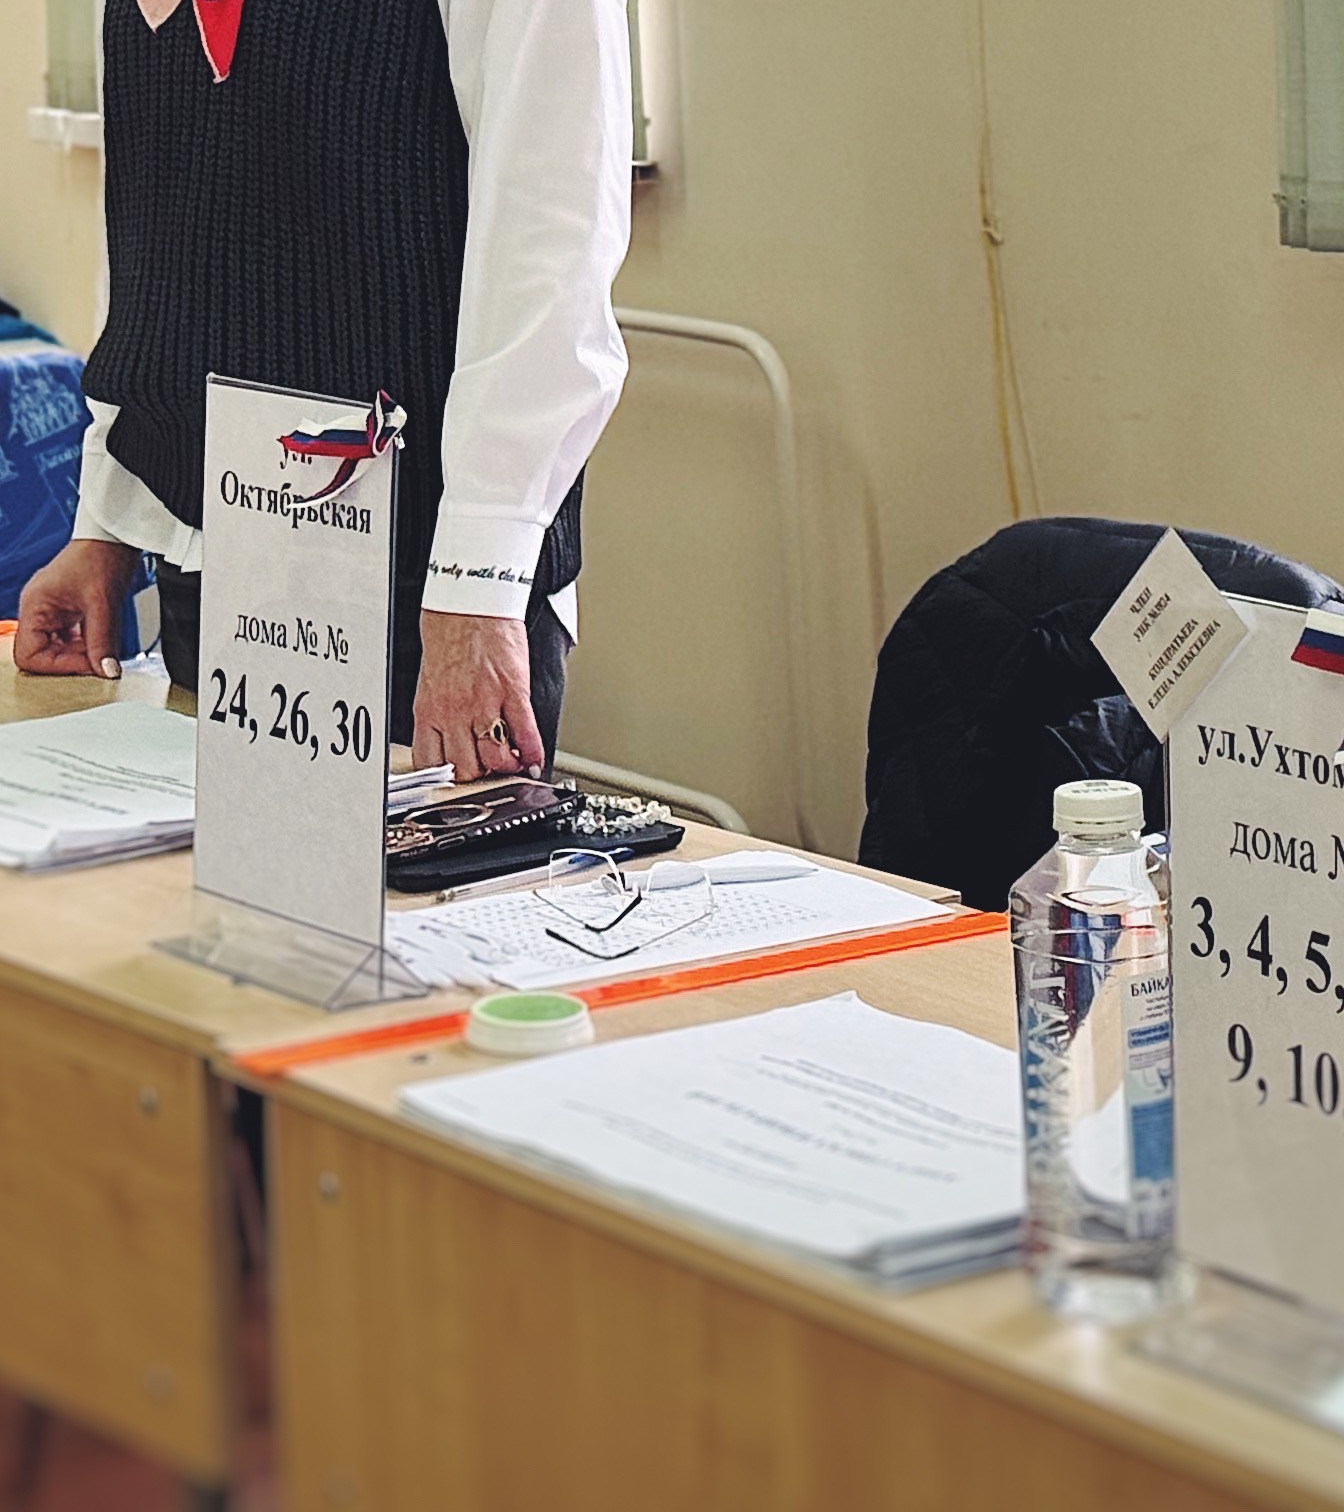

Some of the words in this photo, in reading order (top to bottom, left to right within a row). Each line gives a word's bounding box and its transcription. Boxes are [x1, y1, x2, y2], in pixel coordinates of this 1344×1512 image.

[220, 469, 371, 535] Октябрьская
[466, 565, 496, 579] with
[235, 614, 288, 649] дома
[293, 617, 318, 656] №
[324, 624, 349, 664] №
[1147, 677, 1175, 710] ЕЛЕНА
[1171, 619, 1222, 682] АЛЕКСЕЕВНА
[1148, 619, 1199, 681] КОНДРАТЬЕВА
[210, 668, 258, 744] 24,
[269, 683, 319, 762] 26,
[331, 700, 372, 763] 30
[1229, 821, 1318, 876] дома
[1190, 896, 1233, 977] 3,
[1246, 915, 1289, 995] 4,
[1130, 976, 1170, 997] БАЙКА
[1227, 1023, 1268, 1105] 9,
